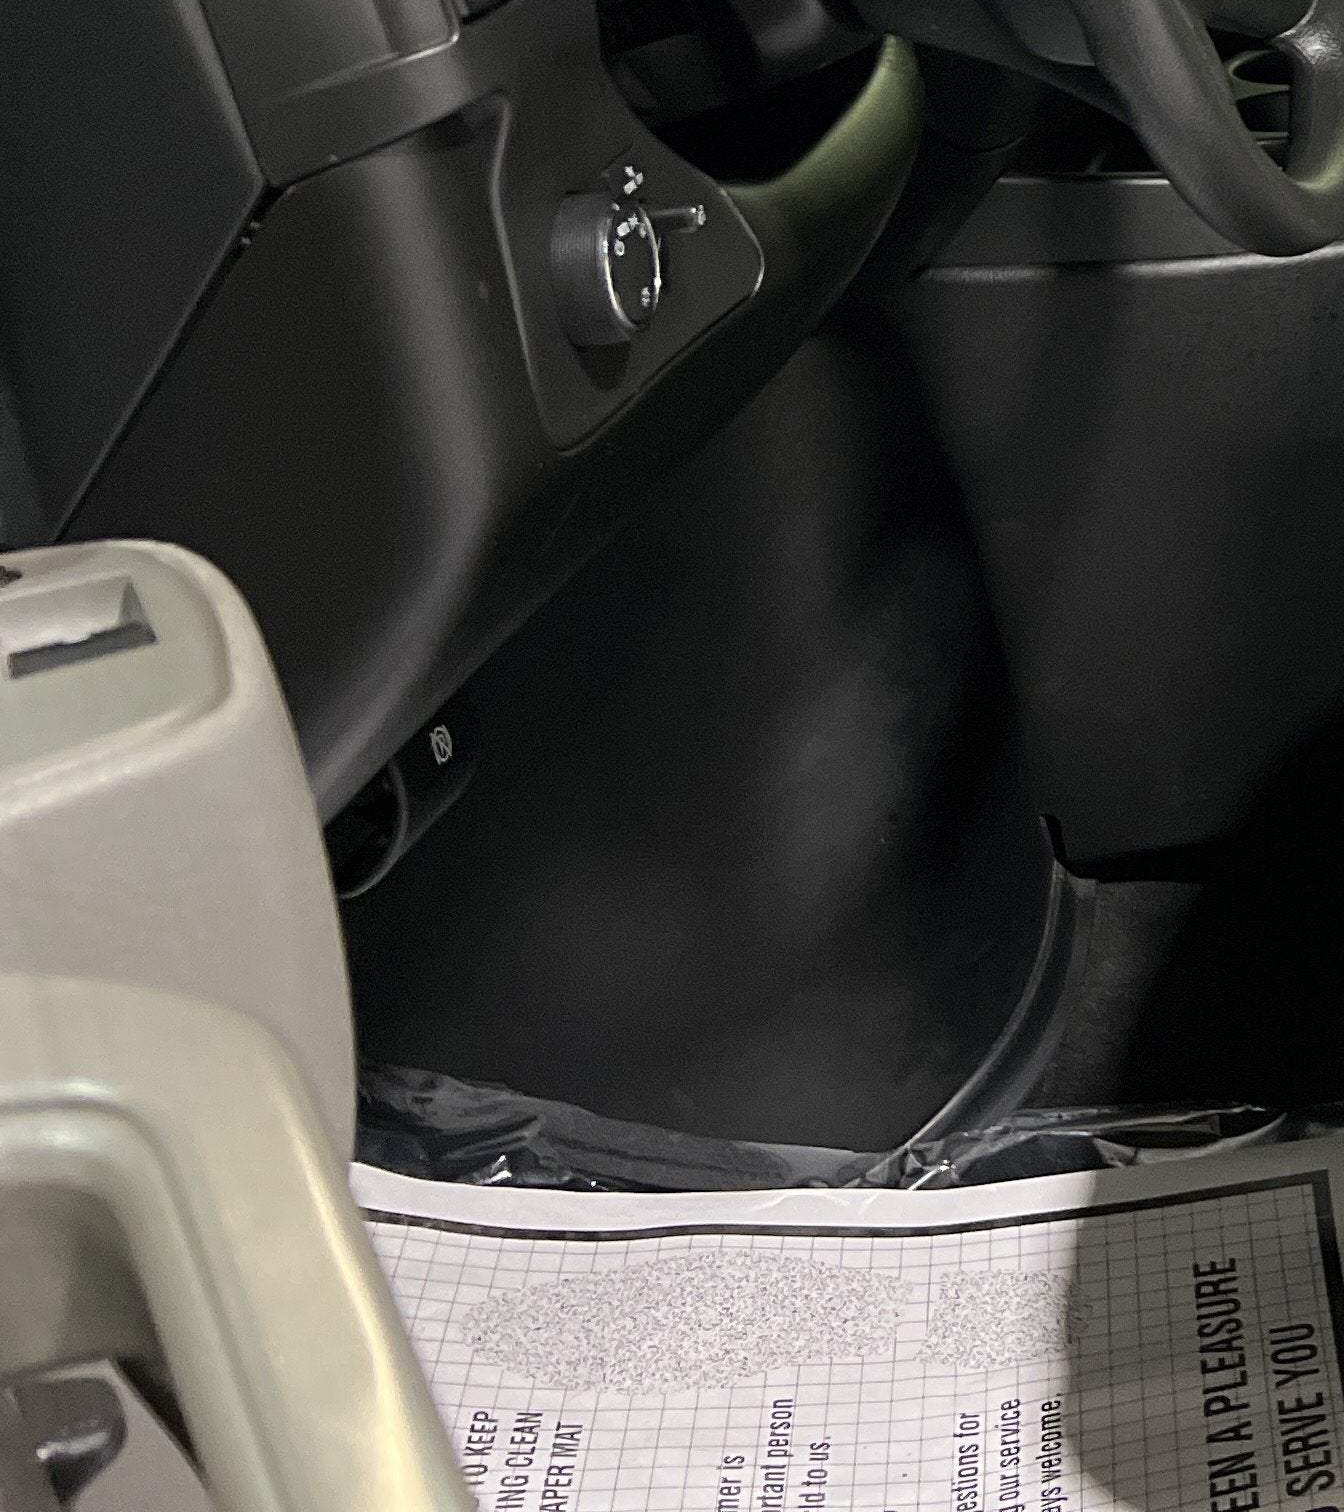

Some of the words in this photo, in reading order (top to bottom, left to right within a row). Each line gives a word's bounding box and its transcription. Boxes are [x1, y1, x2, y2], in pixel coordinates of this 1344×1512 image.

[1193, 1257, 1250, 1417] PLEASURE
[1269, 1323, 1320, 1389] YOU
[463, 1410, 499, 1456] KEEP
[504, 1412, 543, 1467] CLEAN
[550, 1420, 584, 1458] MAT
[767, 1398, 794, 1458] person
[953, 1412, 980, 1437] for
[994, 1398, 1021, 1467] service
[1206, 1420, 1253, 1443] A
[1277, 1391, 1336, 1497] SERVE
[716, 1455, 745, 1470] is
[801, 1468, 828, 1486] to
[950, 1443, 979, 1512] estions
[1207, 1451, 1259, 1512] EEN
[494, 1475, 529, 1512] ING
[798, 1492, 826, 1512] ld
[999, 1471, 1020, 1501] our
